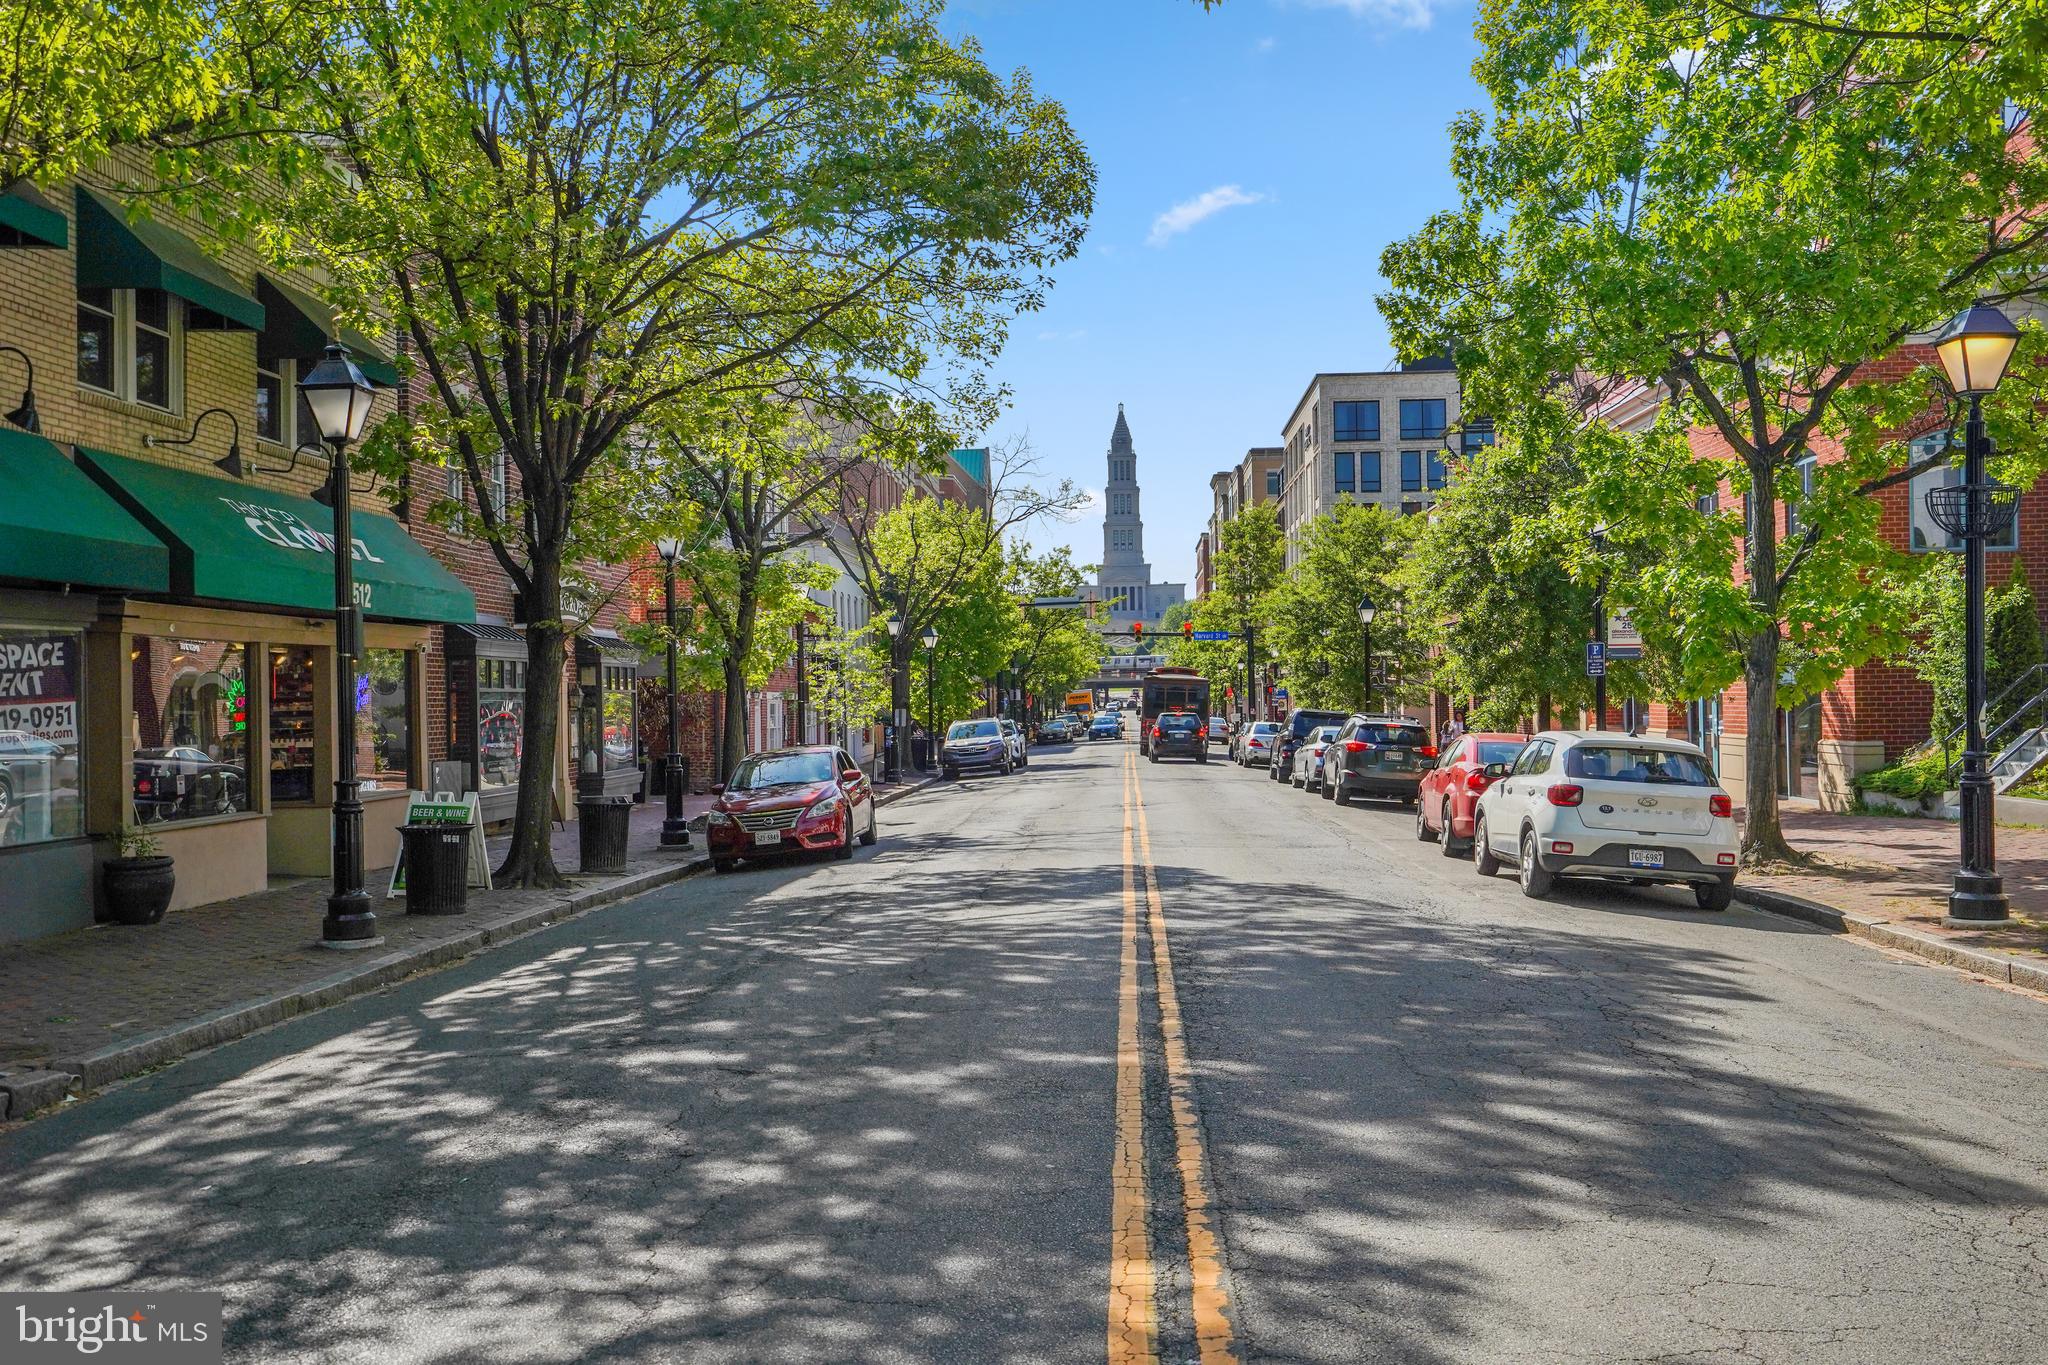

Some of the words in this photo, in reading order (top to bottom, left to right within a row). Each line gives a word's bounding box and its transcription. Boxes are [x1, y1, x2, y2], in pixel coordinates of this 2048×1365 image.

[412, 808, 434, 817] BEER
[436, 809, 443, 817] &
[446, 809, 467, 817] WINE
